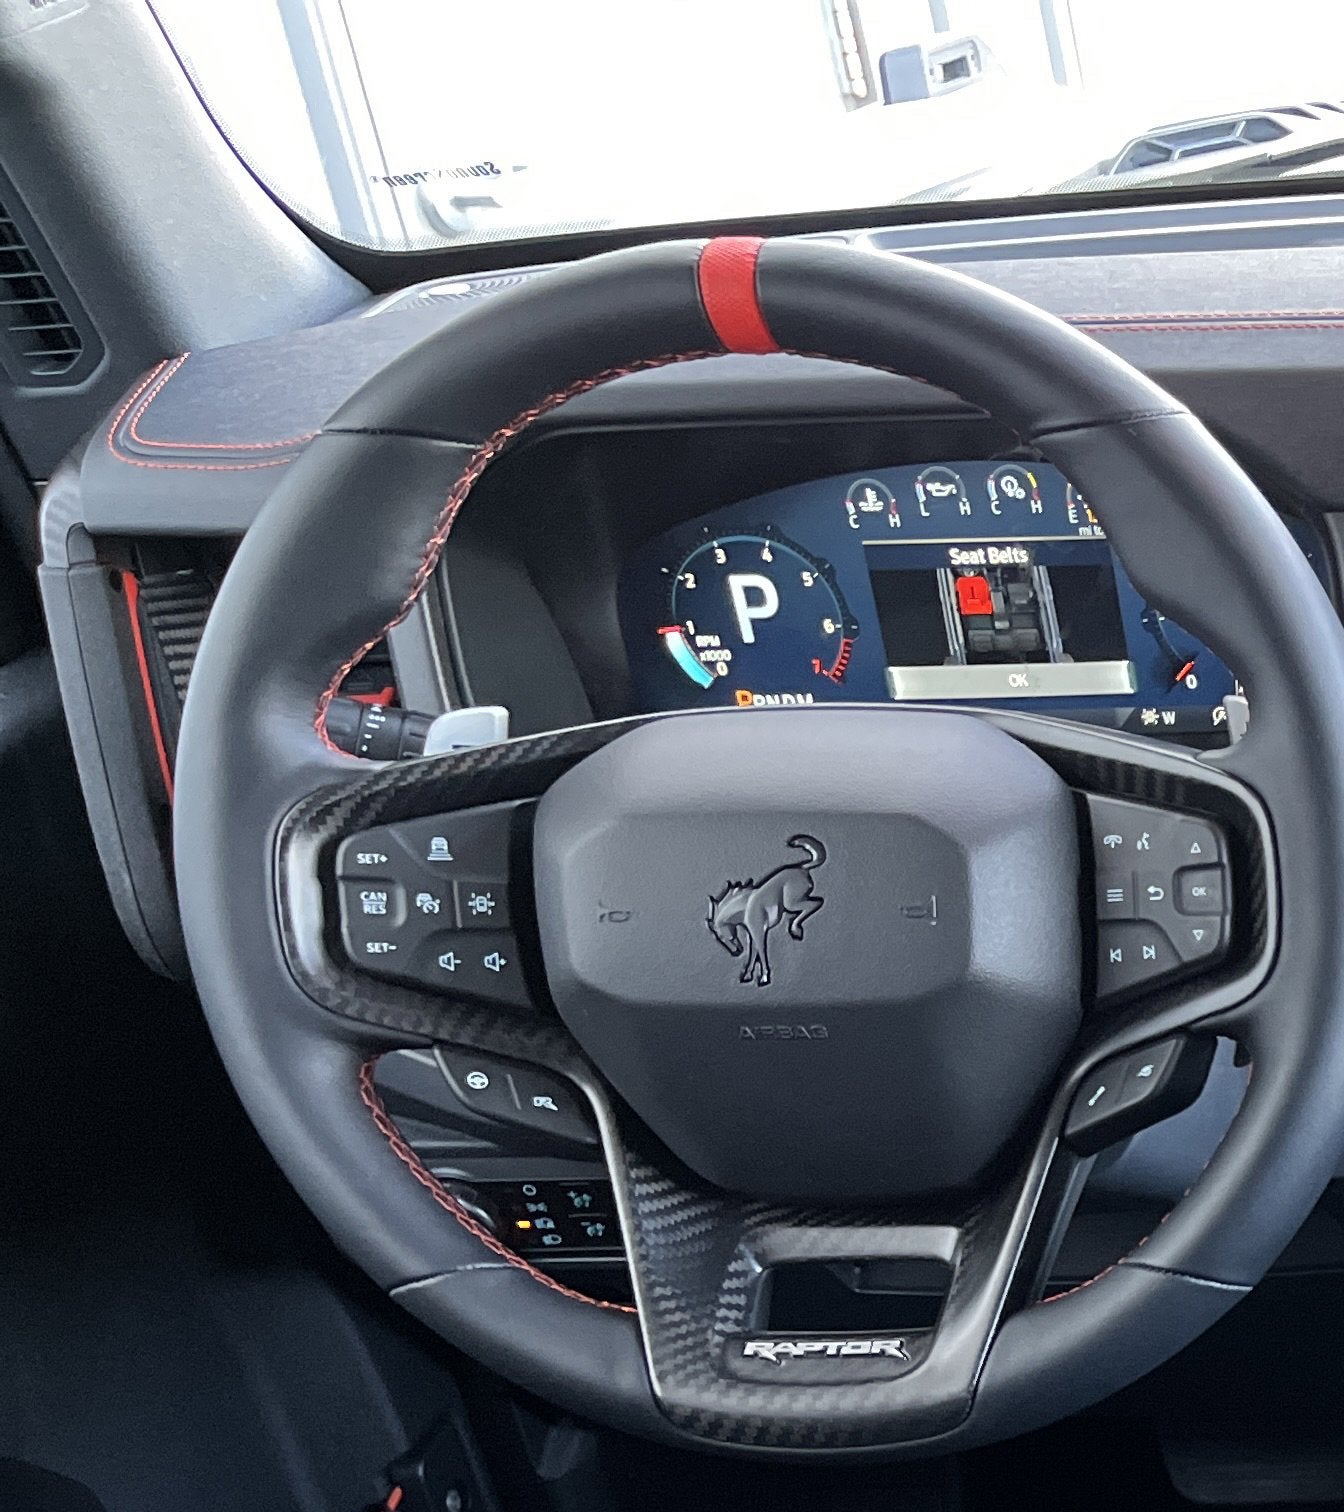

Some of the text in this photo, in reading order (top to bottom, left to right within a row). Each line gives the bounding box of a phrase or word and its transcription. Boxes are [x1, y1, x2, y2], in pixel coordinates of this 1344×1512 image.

[919, 502, 930, 517] L
[958, 501, 971, 515] H
[990, 501, 1002, 515] C
[1030, 500, 1042, 514] H
[849, 514, 860, 529] C
[888, 514, 901, 528] H
[1068, 509, 1079, 523] E
[715, 548, 726, 564] 3
[762, 548, 773, 562] 4
[949, 546, 1029, 565] Seat Belts
[684, 572, 696, 589] 2
[802, 572, 813, 587] 5
[728, 574, 779, 643] P
[686, 620, 695, 635] 1
[823, 619, 835, 634] 6
[695, 635, 721, 648] RPM
[716, 661, 728, 676] 0
[1008, 673, 1029, 687] OK
[1186, 674, 1197, 690] 0
[1162, 711, 1176, 725] W
[357, 853, 388, 865] SET+
[360, 891, 388, 902] CAN
[1192, 886, 1207, 897] OK
[363, 903, 387, 915] RES
[366, 942, 397, 953] SET-
[739, 1025, 829, 1041] AIRBAG
[743, 1339, 911, 1366] RAPTOR
